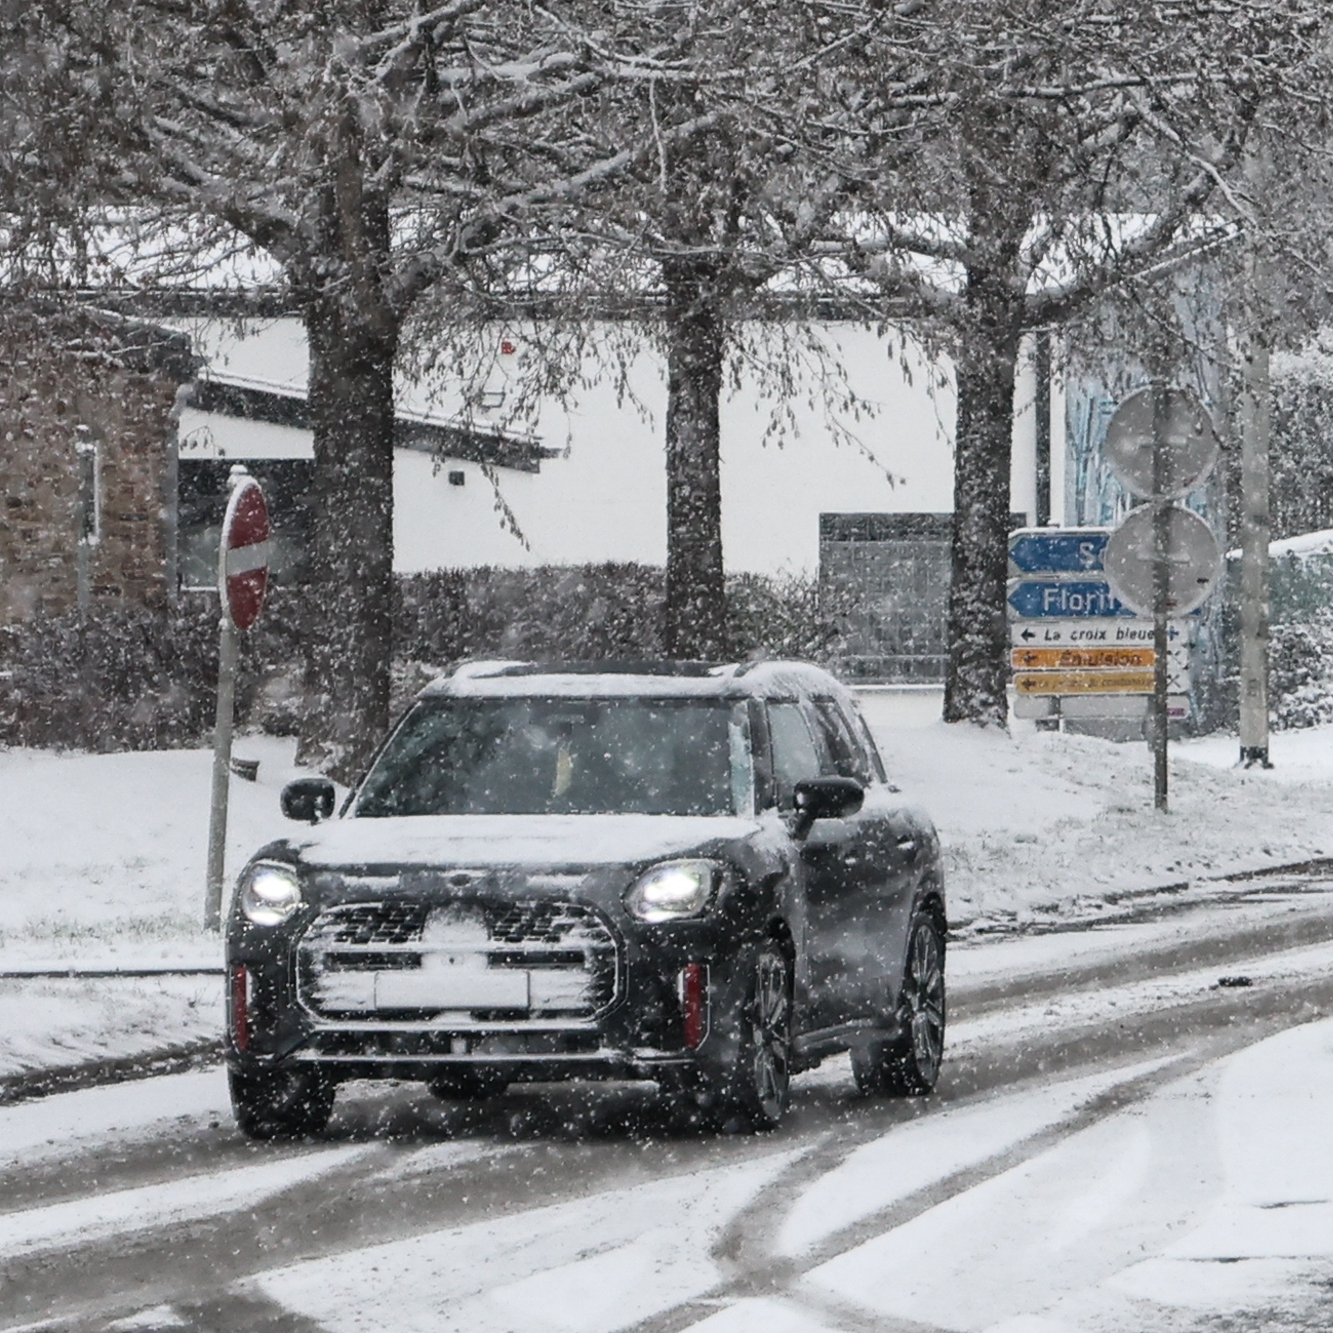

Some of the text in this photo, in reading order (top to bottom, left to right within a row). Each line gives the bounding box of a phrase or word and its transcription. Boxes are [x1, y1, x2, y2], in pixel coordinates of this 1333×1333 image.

[1044, 626, 1155, 641] La croix bleue
